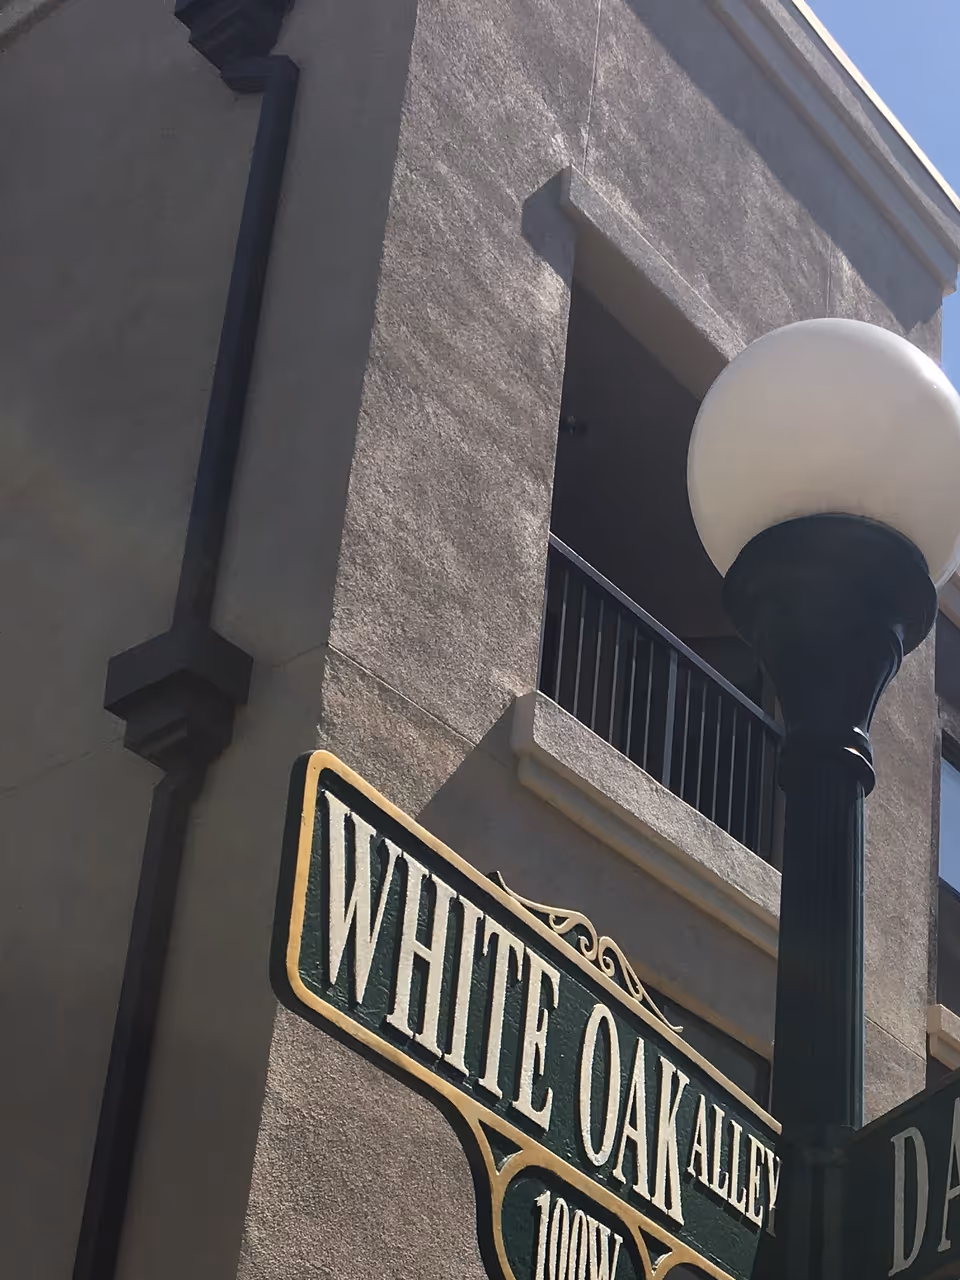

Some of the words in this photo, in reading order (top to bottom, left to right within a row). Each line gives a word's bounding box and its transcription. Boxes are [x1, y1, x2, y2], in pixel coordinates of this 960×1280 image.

[325, 788, 562, 1132] WHITE
[579, 1003, 691, 1225] OAK
[687, 1092, 783, 1238] ALLEY
